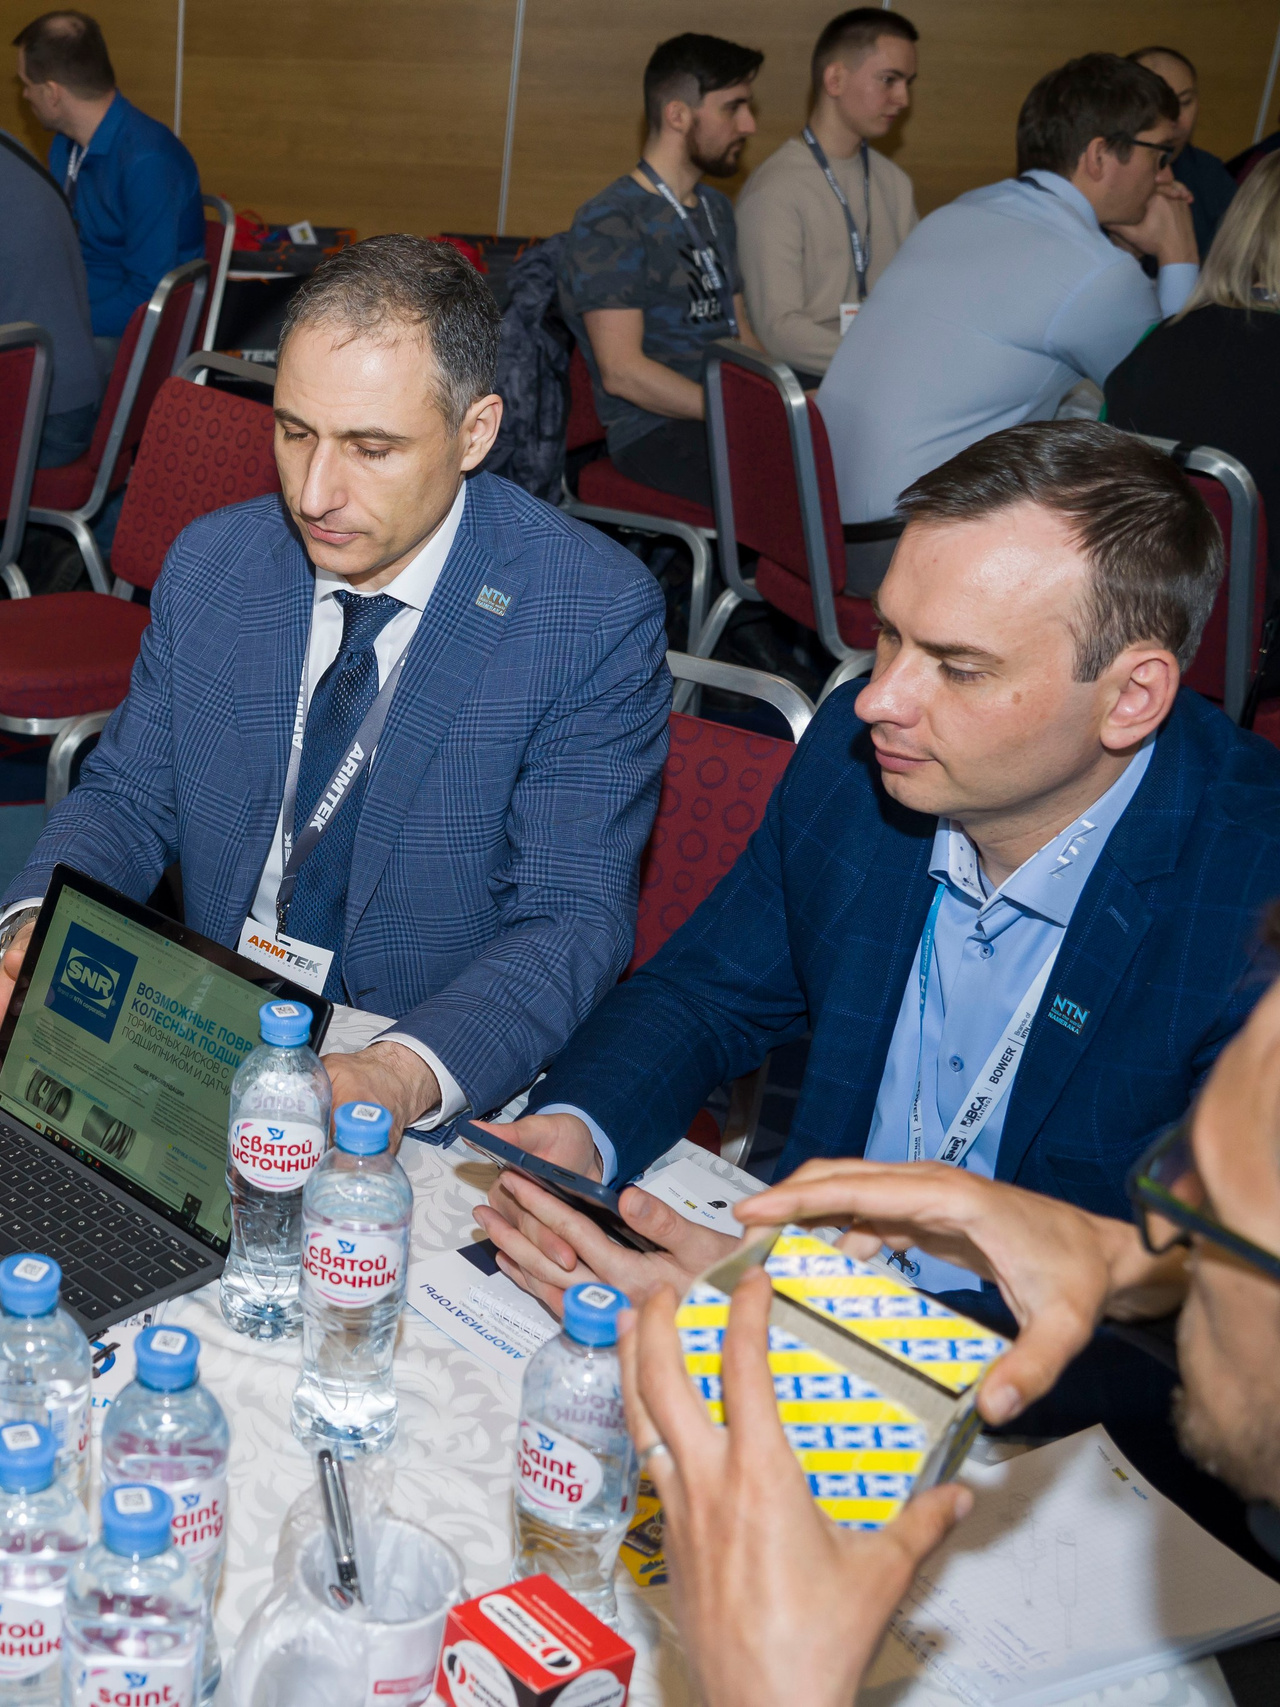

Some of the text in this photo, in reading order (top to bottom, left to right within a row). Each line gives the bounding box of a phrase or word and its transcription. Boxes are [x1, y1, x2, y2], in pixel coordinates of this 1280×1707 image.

[481, 585, 512, 610] NTN
[309, 741, 365, 833] ARMTEK
[247, 934, 322, 975] ARMTEK
[67, 961, 113, 998] SNR
[136, 982, 217, 1036] ВОЗМОЖНЫЕ
[217, 1027, 253, 1054] ПОВР
[1053, 994, 1088, 1024] NTN
[127, 1013, 181, 1052] ТОРМОЗНЫХ
[180, 1045, 220, 1074] ДИСКОВ
[131, 998, 198, 1044] КОЛЕСНЫХ
[198, 1036, 241, 1069] ПОДШИ
[121, 1026, 193, 1075] ПОДШИПНИКОМ
[194, 1068, 202, 1080] И
[201, 1073, 231, 1096] ДАТЧИ
[989, 1045, 1017, 1085] BOWER
[968, 1094, 989, 1127] BCA
[944, 1137, 964, 1161] SNR
[420, 1283, 527, 1360] АМОРТИЗАТОРЫ
[172, 1500, 218, 1528] aint
[173, 1515, 223, 1546] ring
[98, 1685, 172, 1704] saint
